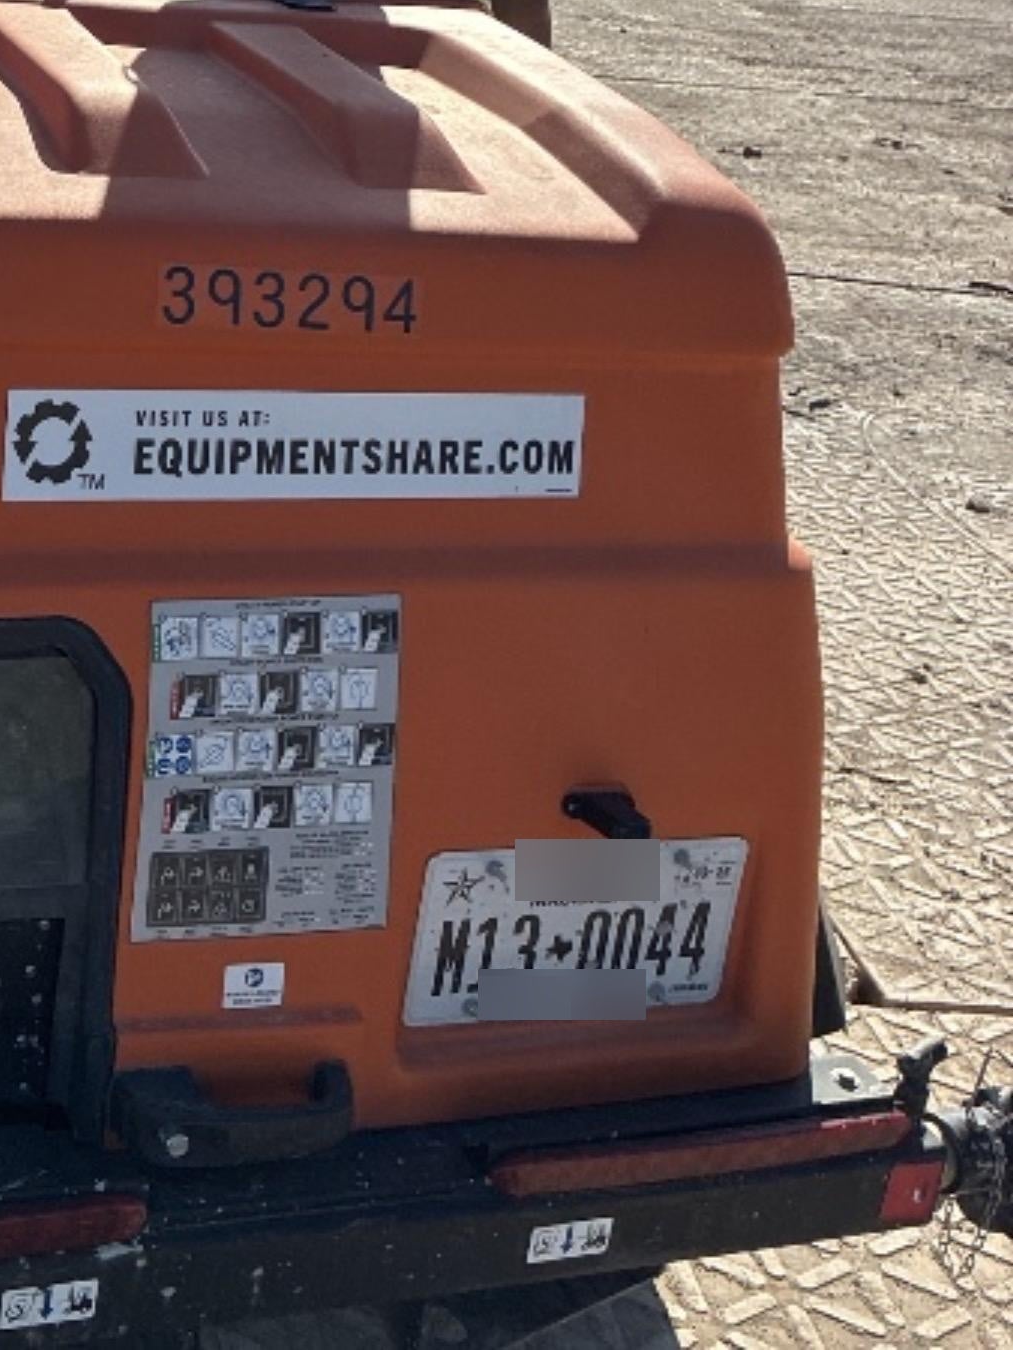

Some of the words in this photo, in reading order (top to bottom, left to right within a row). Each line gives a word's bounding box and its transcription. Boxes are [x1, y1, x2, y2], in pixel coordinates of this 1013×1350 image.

[161, 265, 418, 334] 393294
[135, 410, 193, 427] VISIT
[202, 410, 229, 427] US
[238, 410, 272, 427] AT:
[133, 437, 575, 478] EQUIPMENTSHARE.COM
